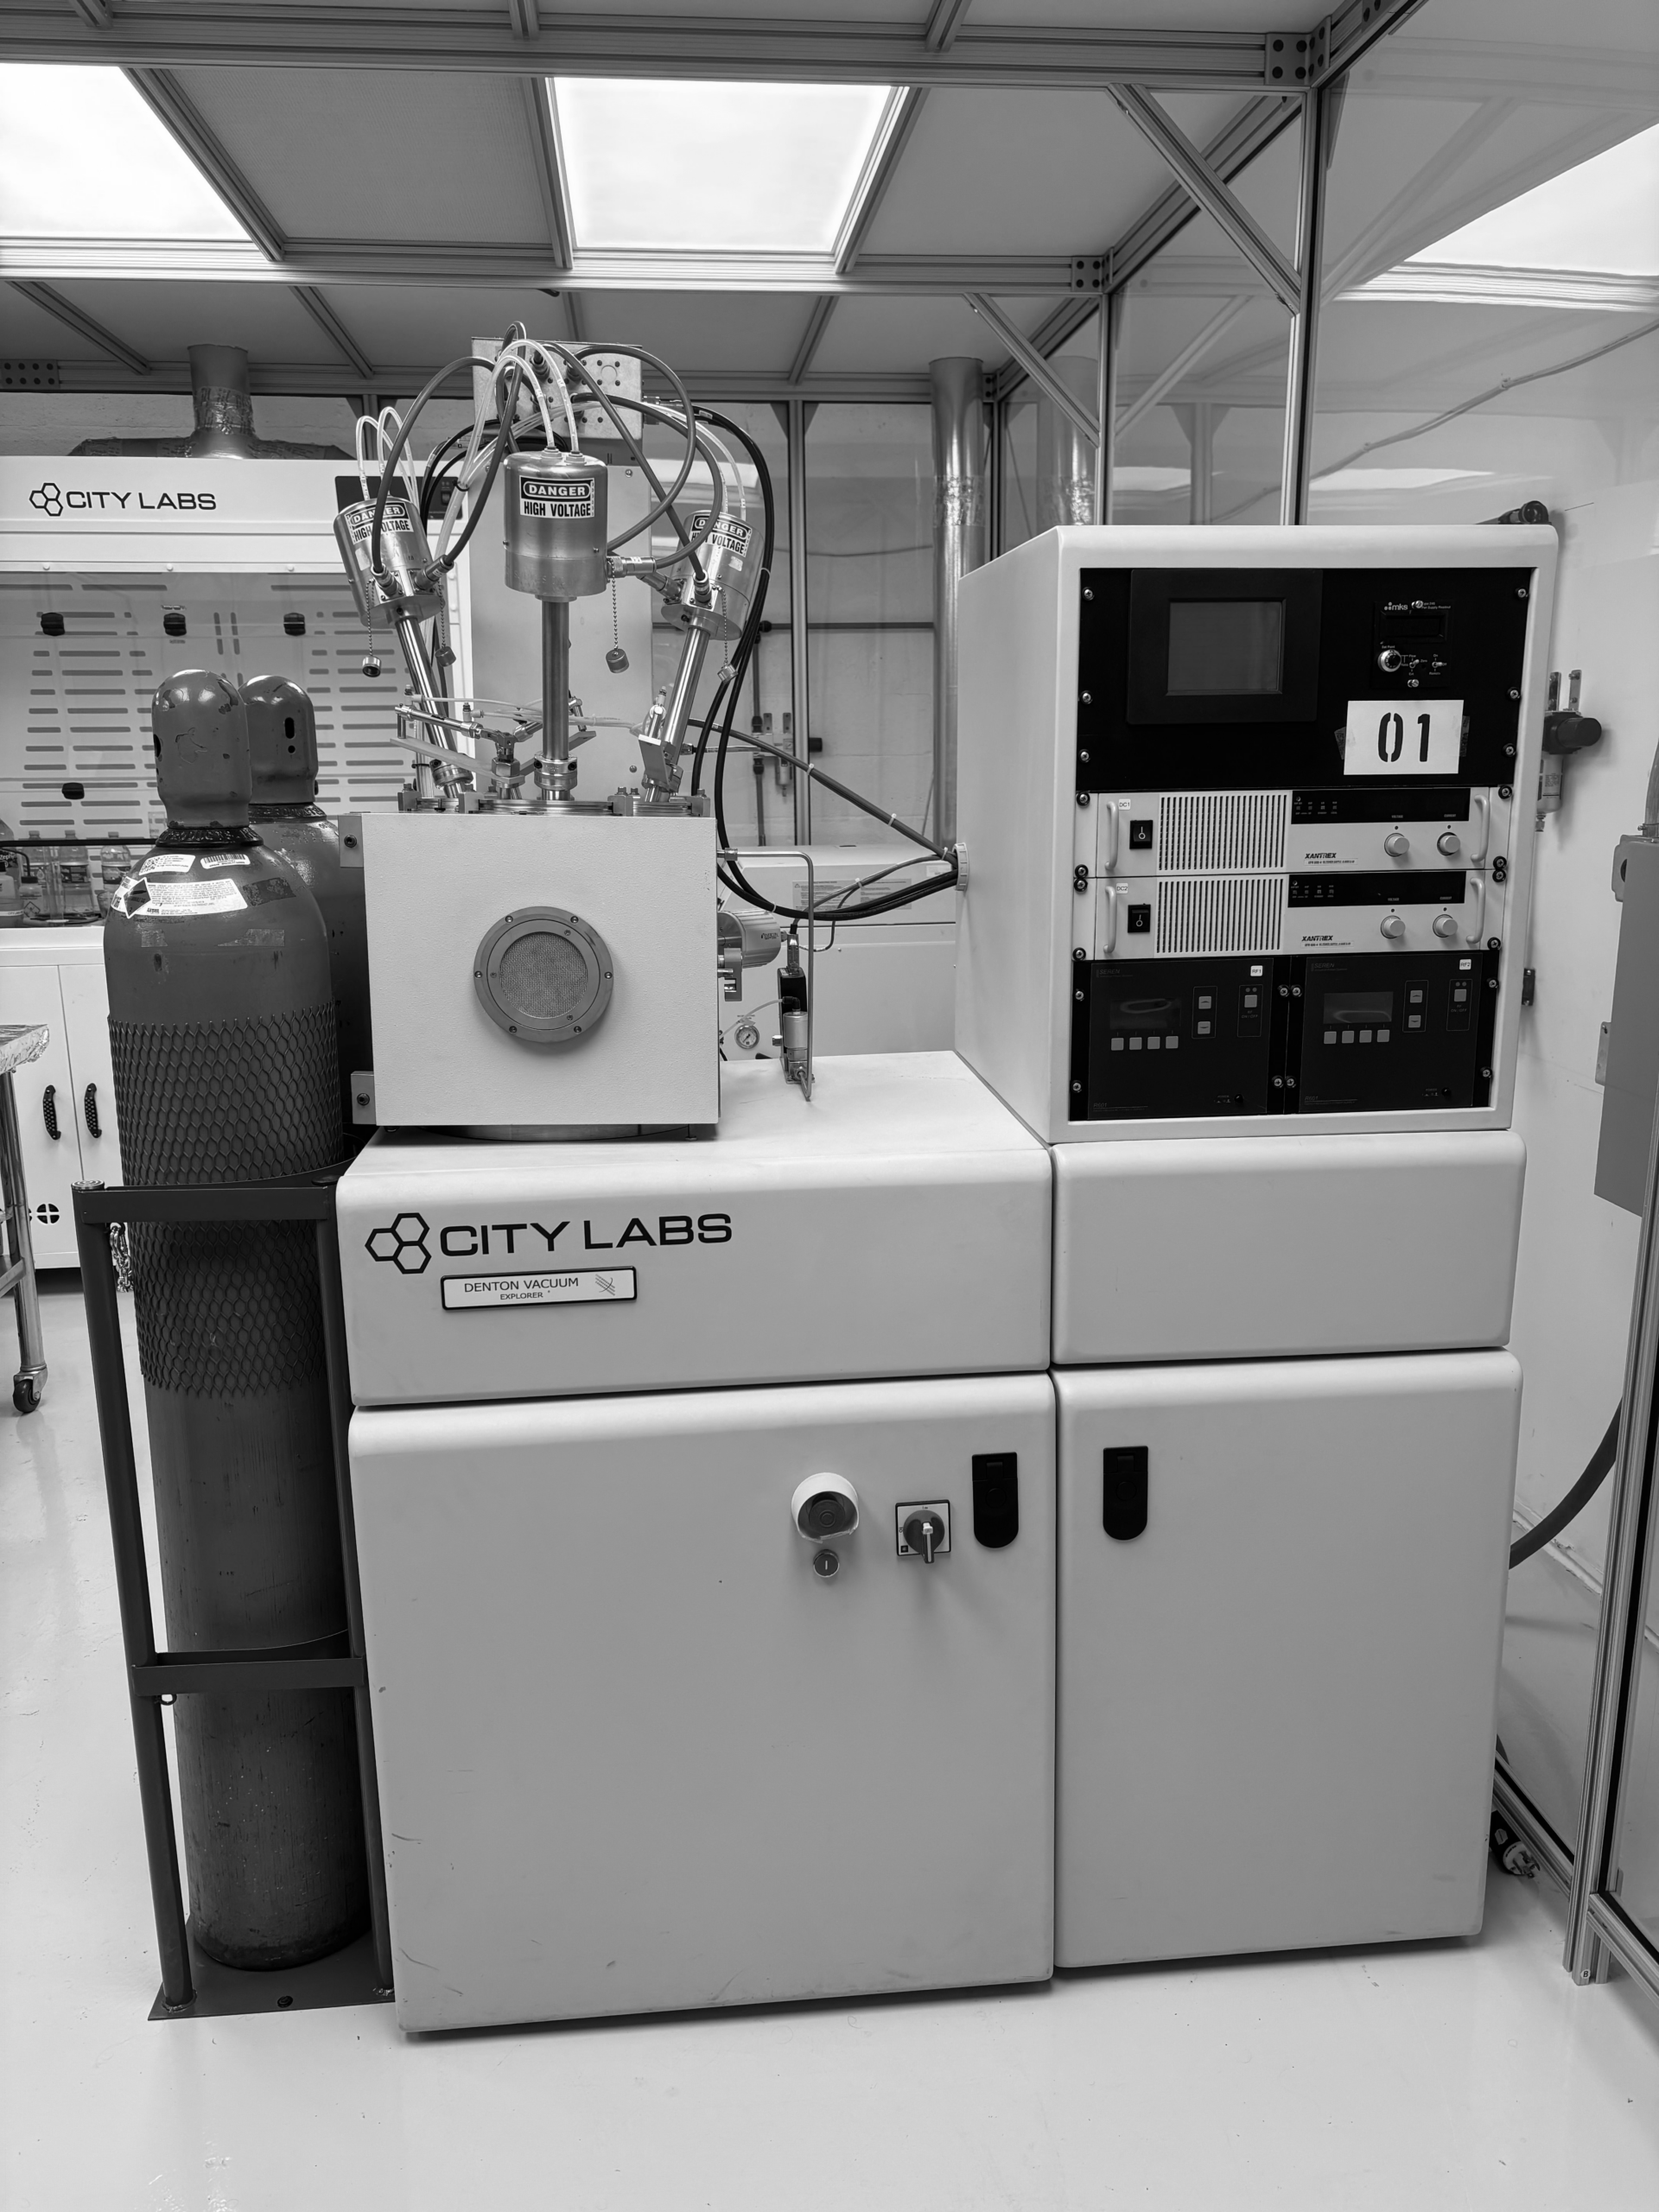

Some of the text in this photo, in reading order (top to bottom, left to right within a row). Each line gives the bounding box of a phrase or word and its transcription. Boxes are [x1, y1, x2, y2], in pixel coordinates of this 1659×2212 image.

[529, 485, 586, 496] DANGER
[67, 491, 217, 510] CITY LABS
[354, 507, 401, 523] DANER
[524, 501, 591, 518] HIGH VOLTAGE
[380, 519, 410, 532] OLTAGE
[698, 519, 744, 537] DNGER
[712, 534, 745, 555] VOLTAGE
[1377, 712, 1431, 763] 01
[440, 1213, 733, 1256] CITY LABS
[464, 1277, 579, 1294] DENTON VACUUM
[499, 1291, 543, 1300] EXPLORER
